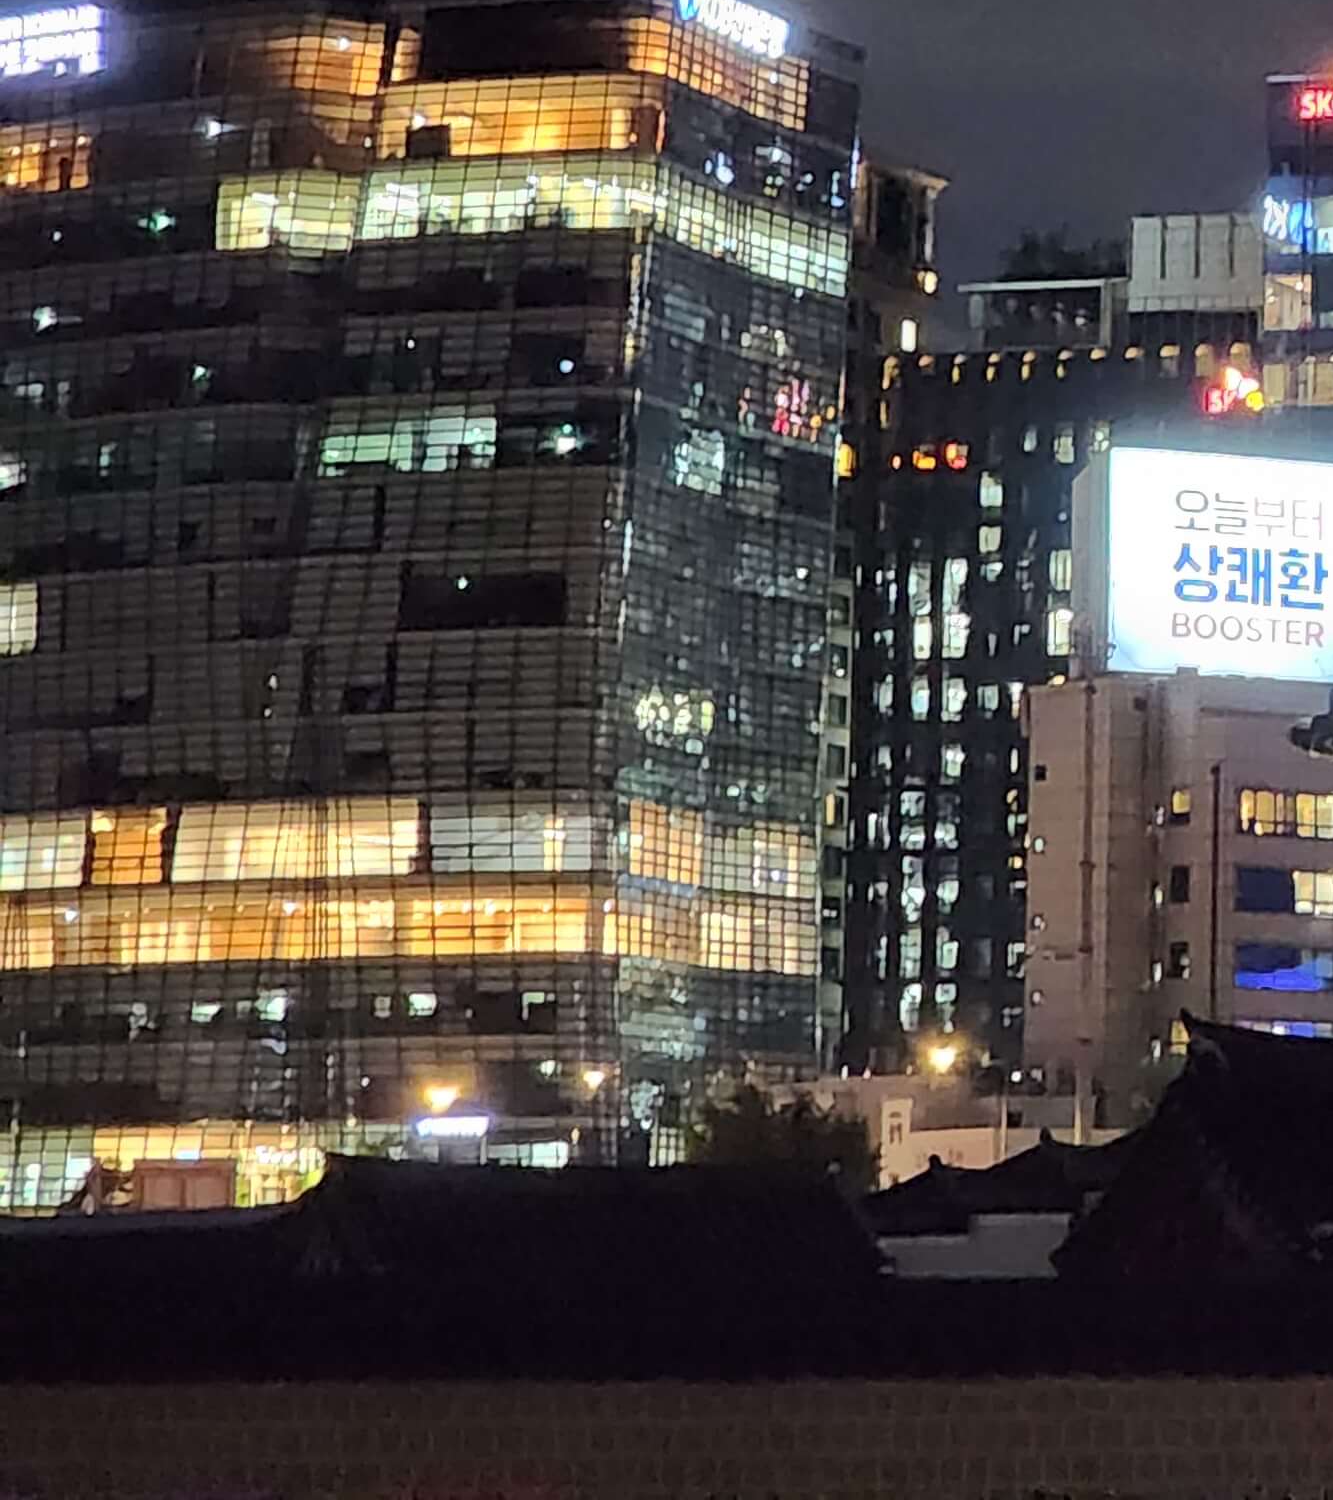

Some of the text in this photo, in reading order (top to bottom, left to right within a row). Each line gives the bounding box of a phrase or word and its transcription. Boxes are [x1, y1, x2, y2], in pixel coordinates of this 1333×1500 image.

[1174, 489, 1324, 541] 오늘부터
[1173, 542, 1329, 612] 상쾌환
[1171, 612, 1325, 649] BOOSTER
